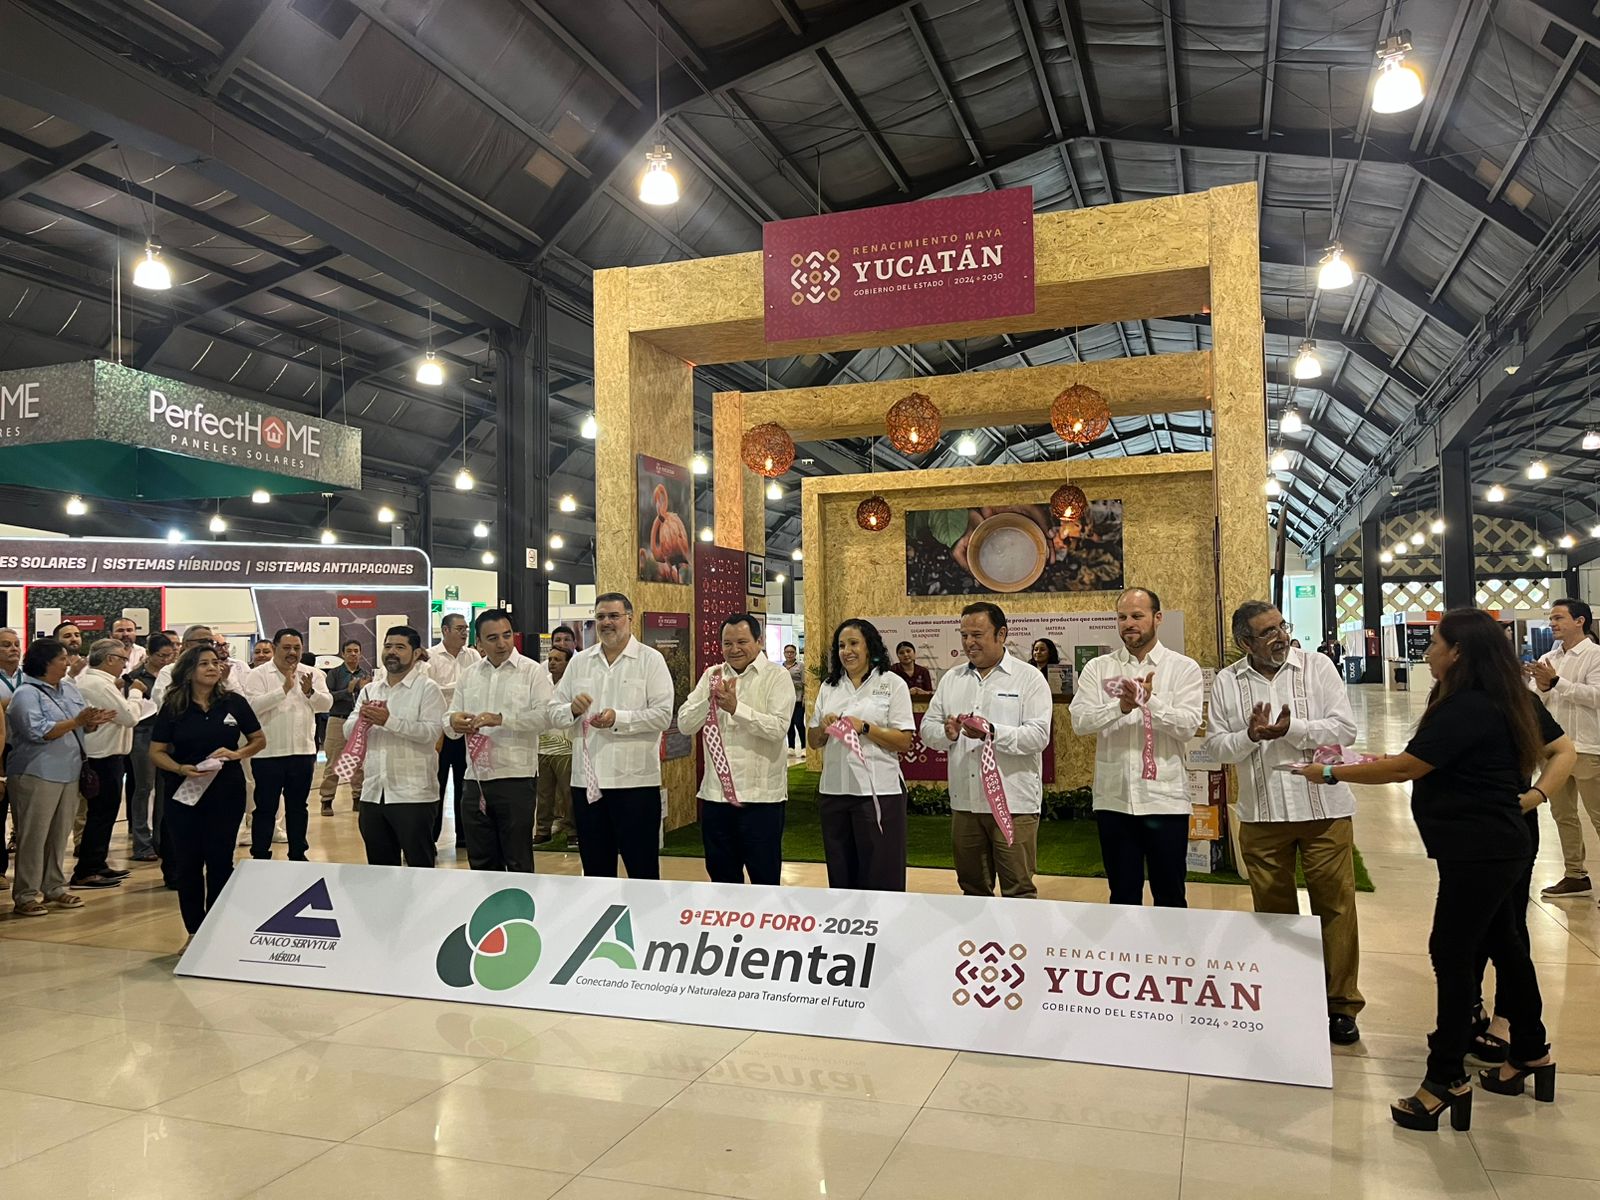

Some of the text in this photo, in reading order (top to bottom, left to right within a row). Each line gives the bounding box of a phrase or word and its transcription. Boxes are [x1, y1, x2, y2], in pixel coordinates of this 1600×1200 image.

[853, 228, 1002, 255] RENACIMIENTO MAYA
[852, 244, 1004, 283] YUCATÁN
[853, 272, 1004, 296] GOBIERNO DEL ESTADO 2024 2030
[171, 434, 304, 469] PANELES SOLARES
[20, 556, 86, 569] SOLARES
[103, 558, 176, 571] SISTEMAS
[178, 556, 241, 572] HÍBRIDOS
[256, 560, 321, 573] SISTEMAS
[322, 562, 414, 575] ANTIAPAGONES
[1049, 616, 1079, 624] productos
[759, 913, 816, 933] FORO
[250, 935, 338, 951] CANACO SERVYTUR
[268, 950, 301, 963] MÉRIDA
[1046, 946, 1260, 973] RENACIMIENTO MAYA
[576, 975, 865, 1009] Conectando Tecnología y Naturaleza para Transformar el Futuro
[1043, 966, 1263, 1012] YUCATÁN
[1042, 1002, 1264, 1033] GOBIERNO DEL ESTADO 2024 2030
